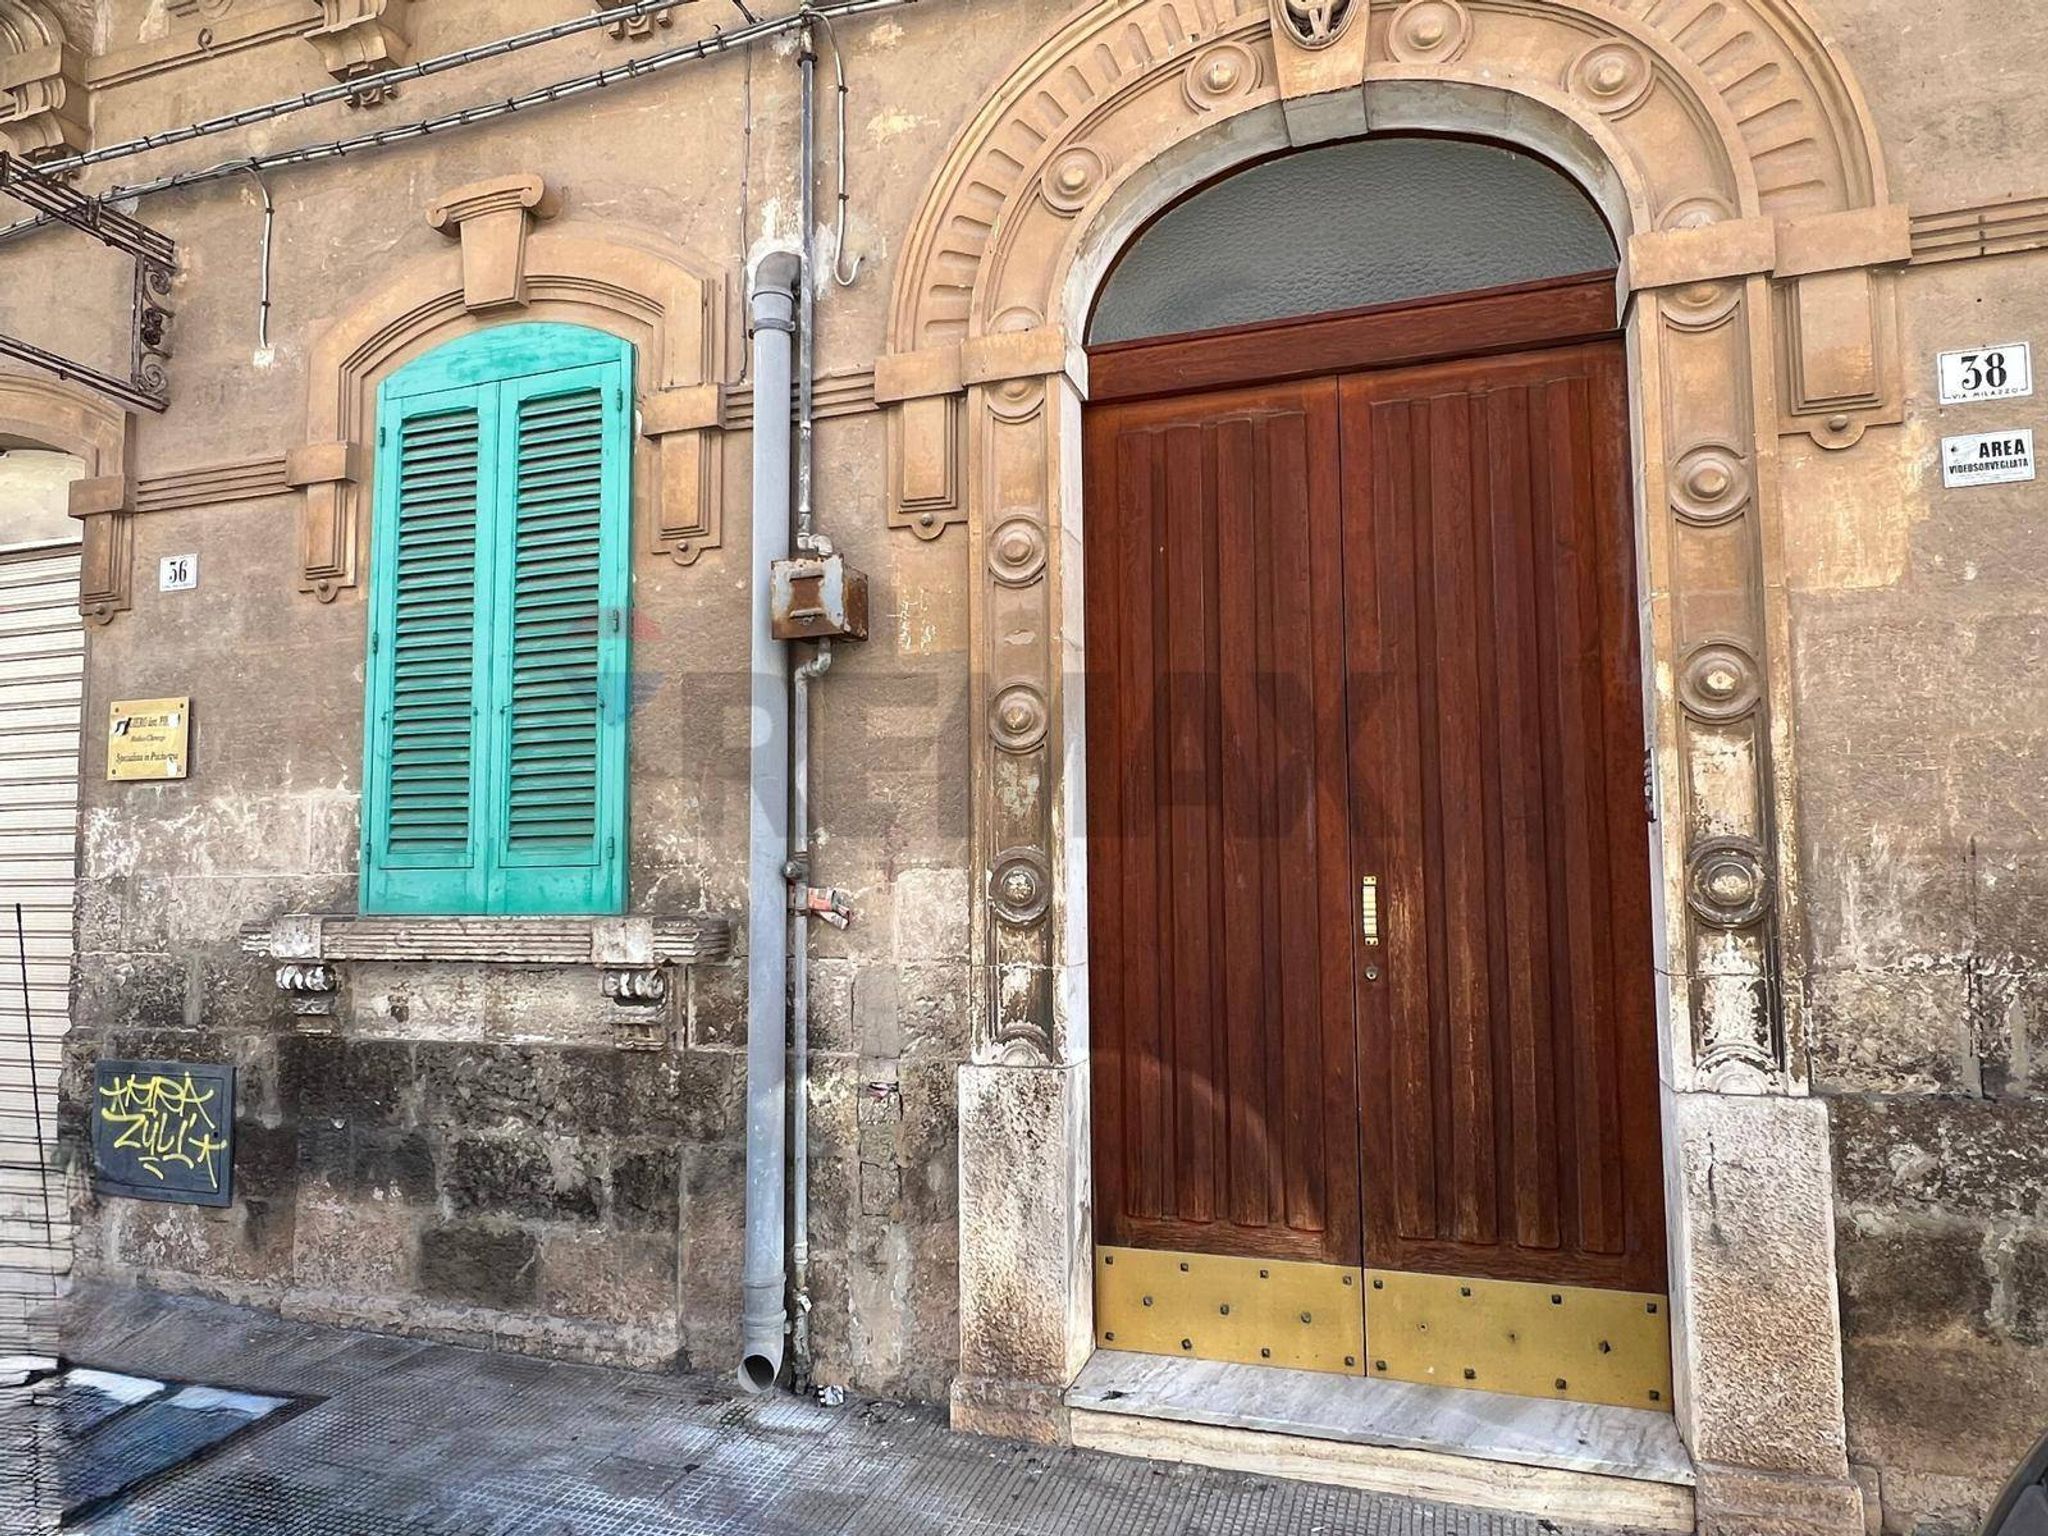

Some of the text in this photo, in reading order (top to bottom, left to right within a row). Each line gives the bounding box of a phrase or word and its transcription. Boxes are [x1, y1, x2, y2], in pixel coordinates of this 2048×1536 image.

[1960, 352, 2007, 391] 38
[1973, 387, 2019, 399] MILAZZO
[1978, 438, 2026, 459] AREA
[1948, 457, 2029, 475] VIDEOSORVEGLIATA
